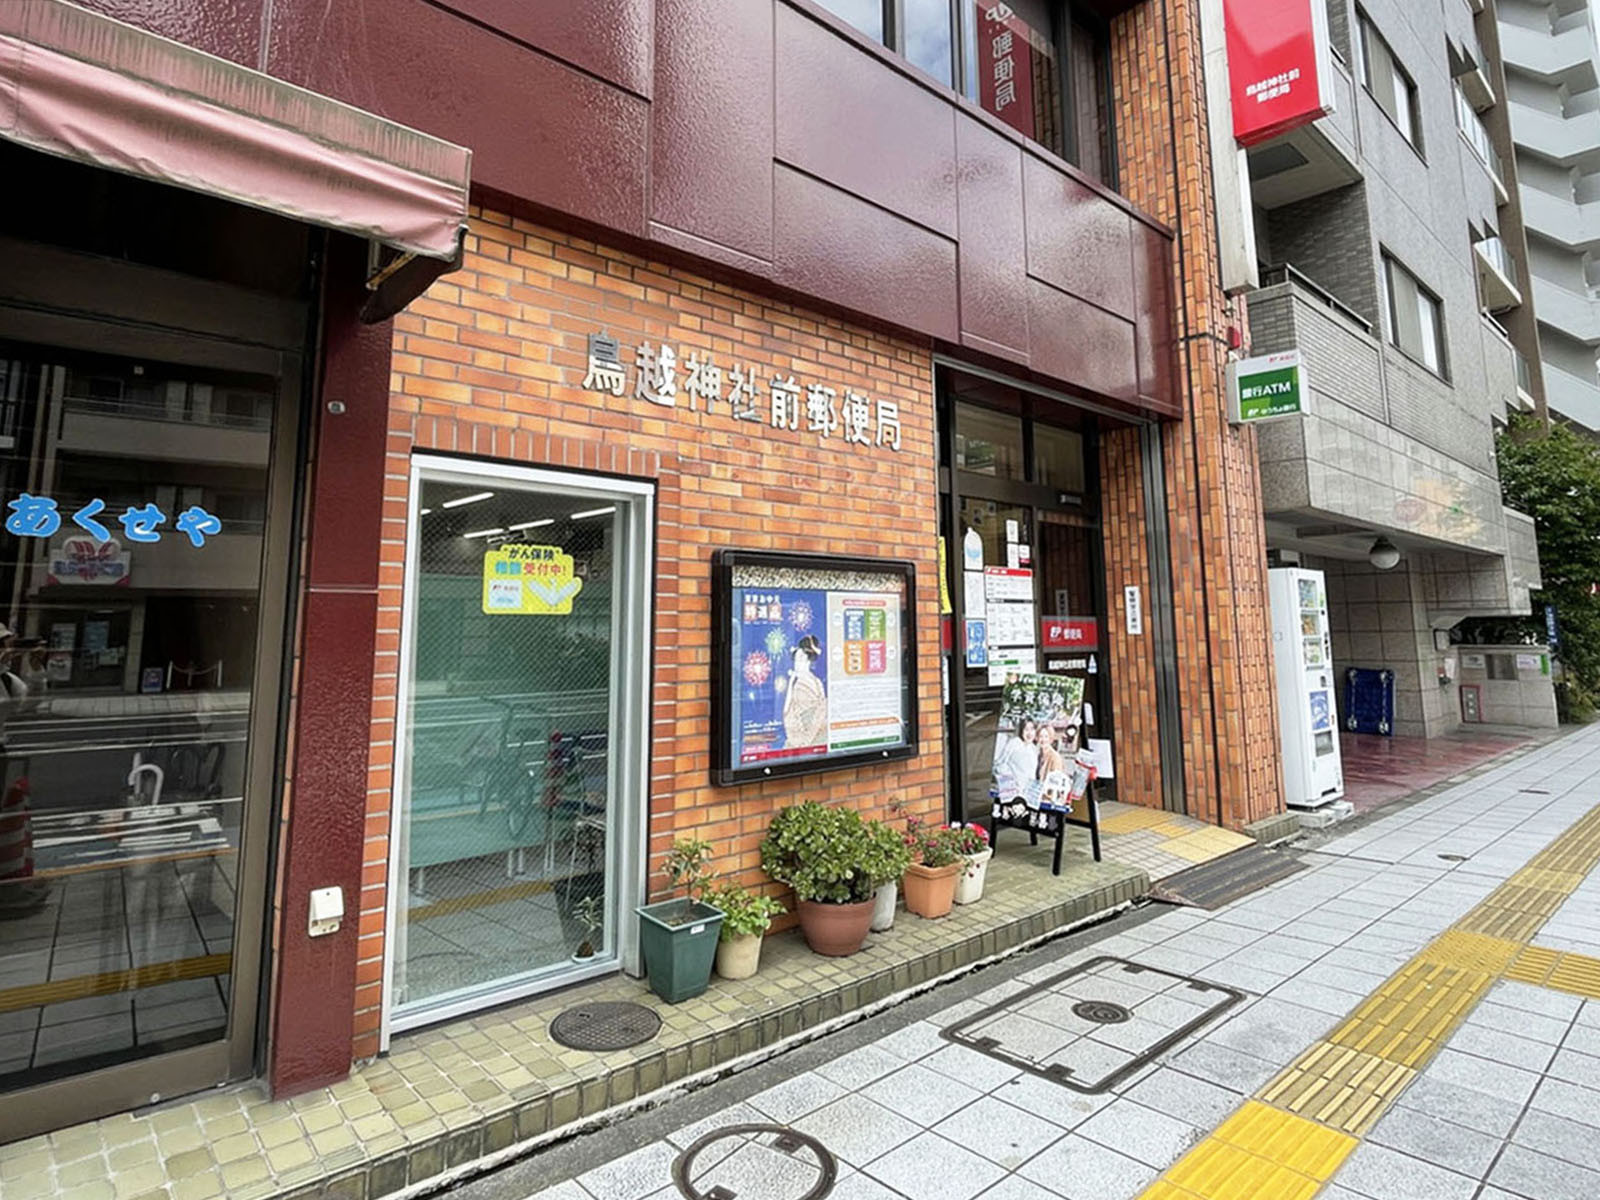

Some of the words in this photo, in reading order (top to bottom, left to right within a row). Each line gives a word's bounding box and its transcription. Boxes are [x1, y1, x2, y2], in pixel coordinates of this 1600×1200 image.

[582, 330, 902, 451] 鳥越神社前郵便局
[5, 493, 222, 547] あくせや
